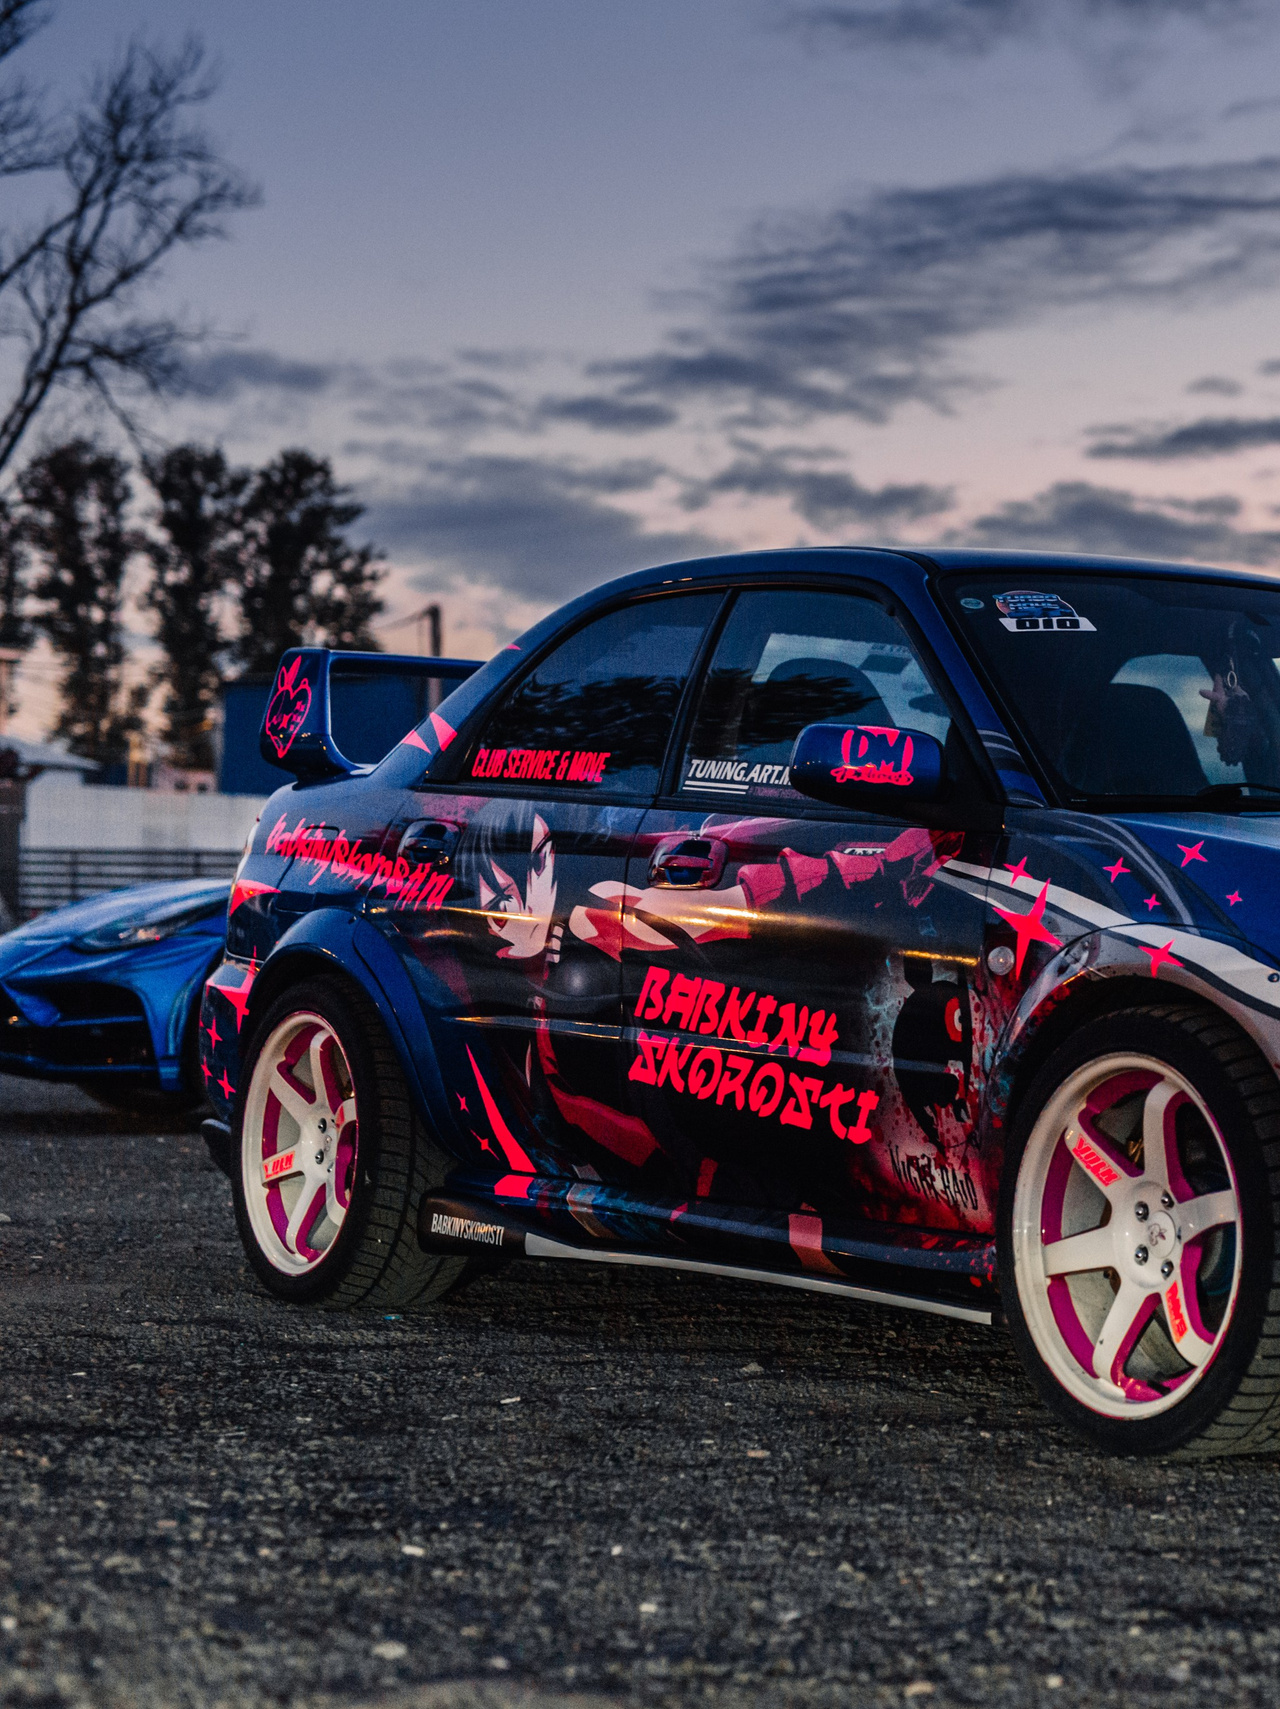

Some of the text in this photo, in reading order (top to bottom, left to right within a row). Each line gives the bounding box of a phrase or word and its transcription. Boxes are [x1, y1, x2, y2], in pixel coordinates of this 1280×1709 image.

[471, 748, 611, 783] CLUB SERVICE & MOVE
[634, 966, 839, 1067] BABKINY
[628, 1031, 880, 1144] SKOROSTI
[431, 1213, 505, 1246] BABKINYSKOROSTI
